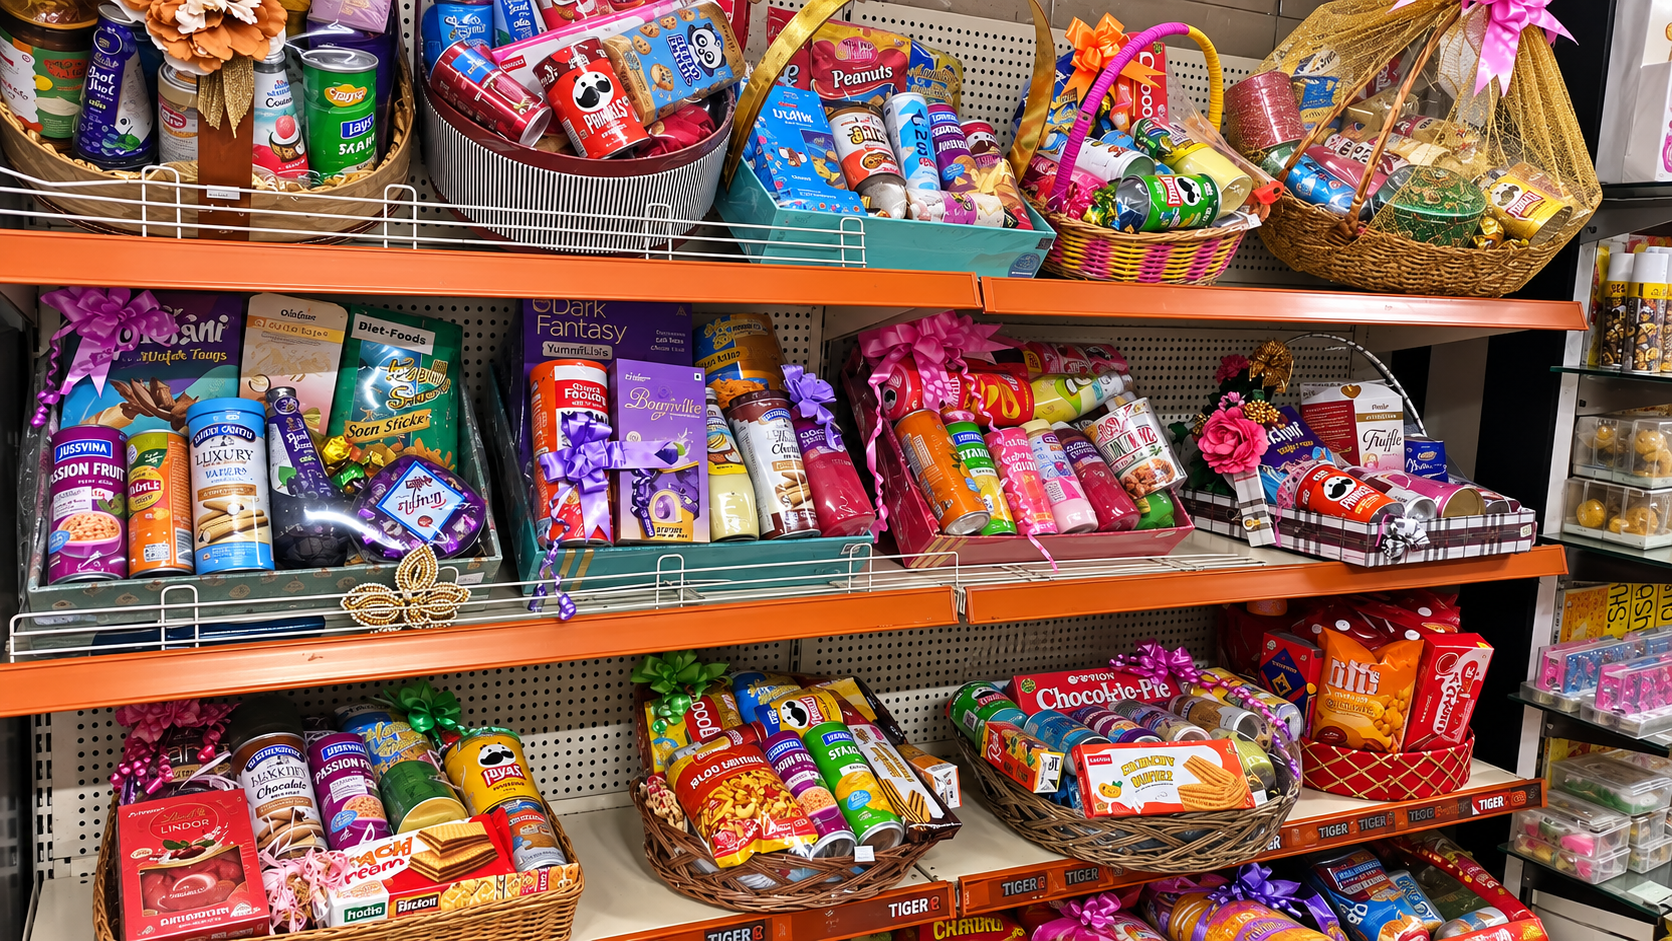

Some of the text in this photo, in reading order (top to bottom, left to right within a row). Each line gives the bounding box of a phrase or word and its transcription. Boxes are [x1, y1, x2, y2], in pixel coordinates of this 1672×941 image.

[832, 64, 893, 89] Peanuts
[553, 299, 607, 318] Dark
[358, 321, 427, 346] Diet-Foods
[537, 315, 628, 344] Fantasy
[1363, 428, 1402, 452] Truffle
[93, 463, 126, 483] FRUIT
[314, 757, 359, 785] PASSION
[1478, 795, 1504, 811] TIGER
[161, 819, 209, 834] LINDOR
[1318, 822, 1348, 839] TIGER
[1358, 814, 1387, 831] TIGER
[1002, 867, 1099, 897] TIGER TIGER
[888, 897, 929, 918] TIGER
